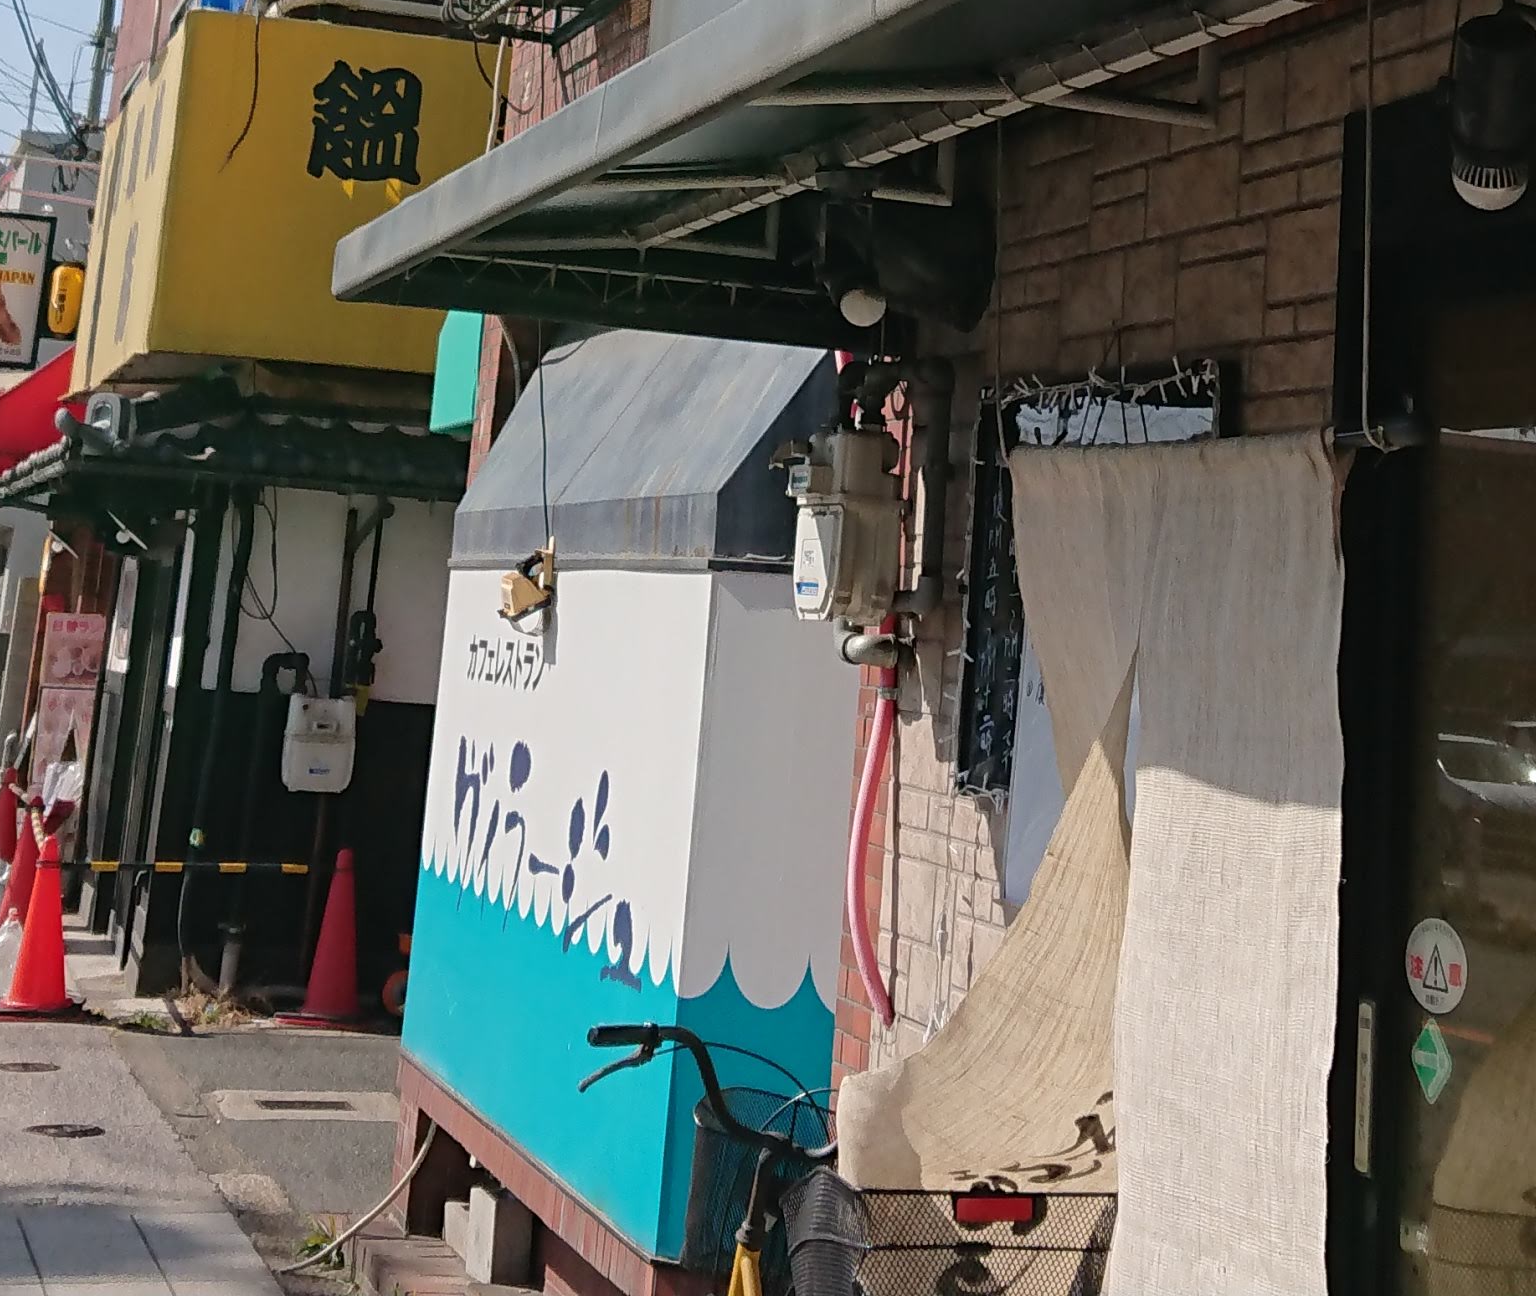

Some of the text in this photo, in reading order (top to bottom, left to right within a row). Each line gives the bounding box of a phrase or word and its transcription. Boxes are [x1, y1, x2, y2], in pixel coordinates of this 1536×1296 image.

[467, 634, 546, 691] カフェレストラン
